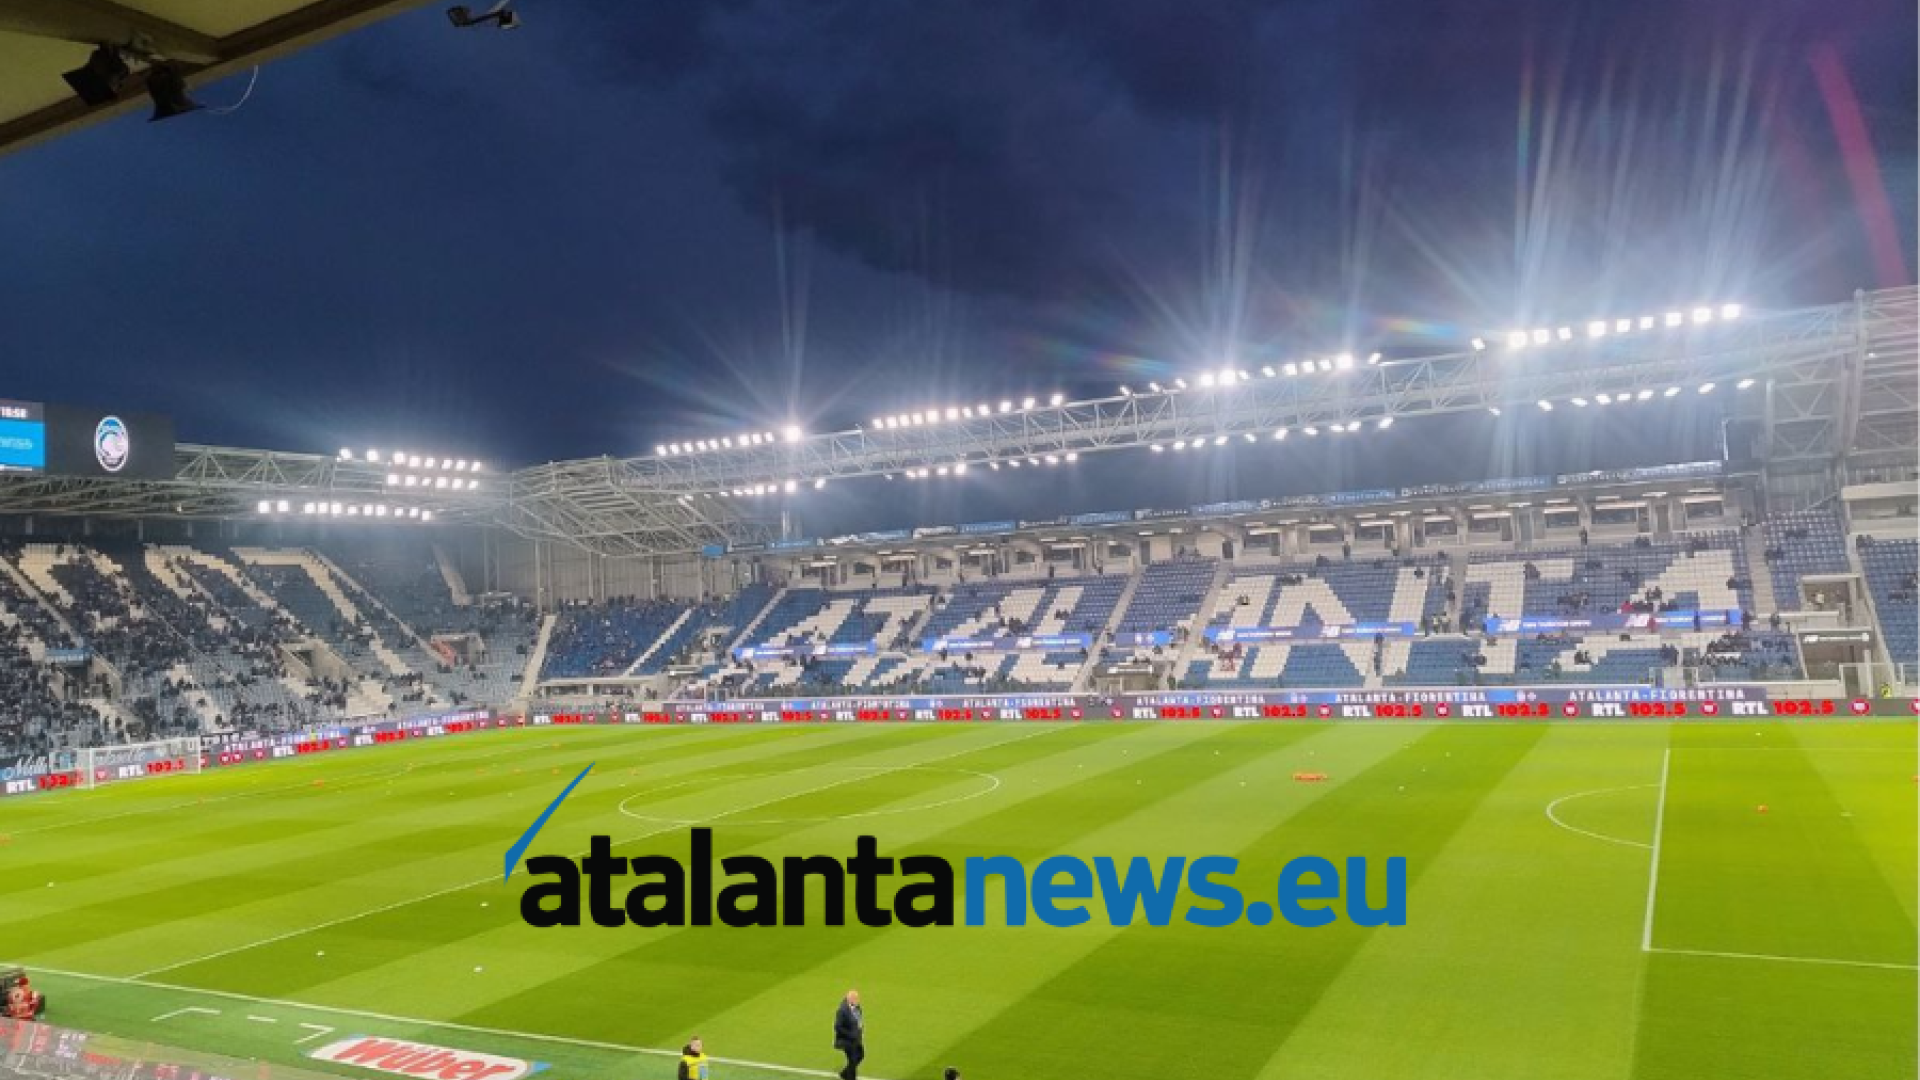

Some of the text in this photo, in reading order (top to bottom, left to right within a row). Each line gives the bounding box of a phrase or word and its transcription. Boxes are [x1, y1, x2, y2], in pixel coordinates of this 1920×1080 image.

[1136, 696, 1265, 705] ATALANTA-FIORENTINA
[1336, 692, 1487, 703] ATALANTA-FIORENTINA
[1569, 690, 1746, 701] ATALANTA-FIORENTINA
[1000, 707, 1061, 719] RTL 102.5
[1133, 706, 1200, 718] RTL 102.5
[1233, 705, 1307, 717] RTL 102.5
[1343, 704, 1423, 717] RTL 102.5
[1462, 703, 1549, 717] RTL 102.5
[1592, 702, 1687, 717] RTL 102.5
[1732, 700, 1835, 715] RTL 102.5
[761, 711, 779, 721] RTL
[836, 711, 855, 721] RTL
[915, 709, 973, 721] RTL 102.5
[6, 779, 36, 793] RTL
